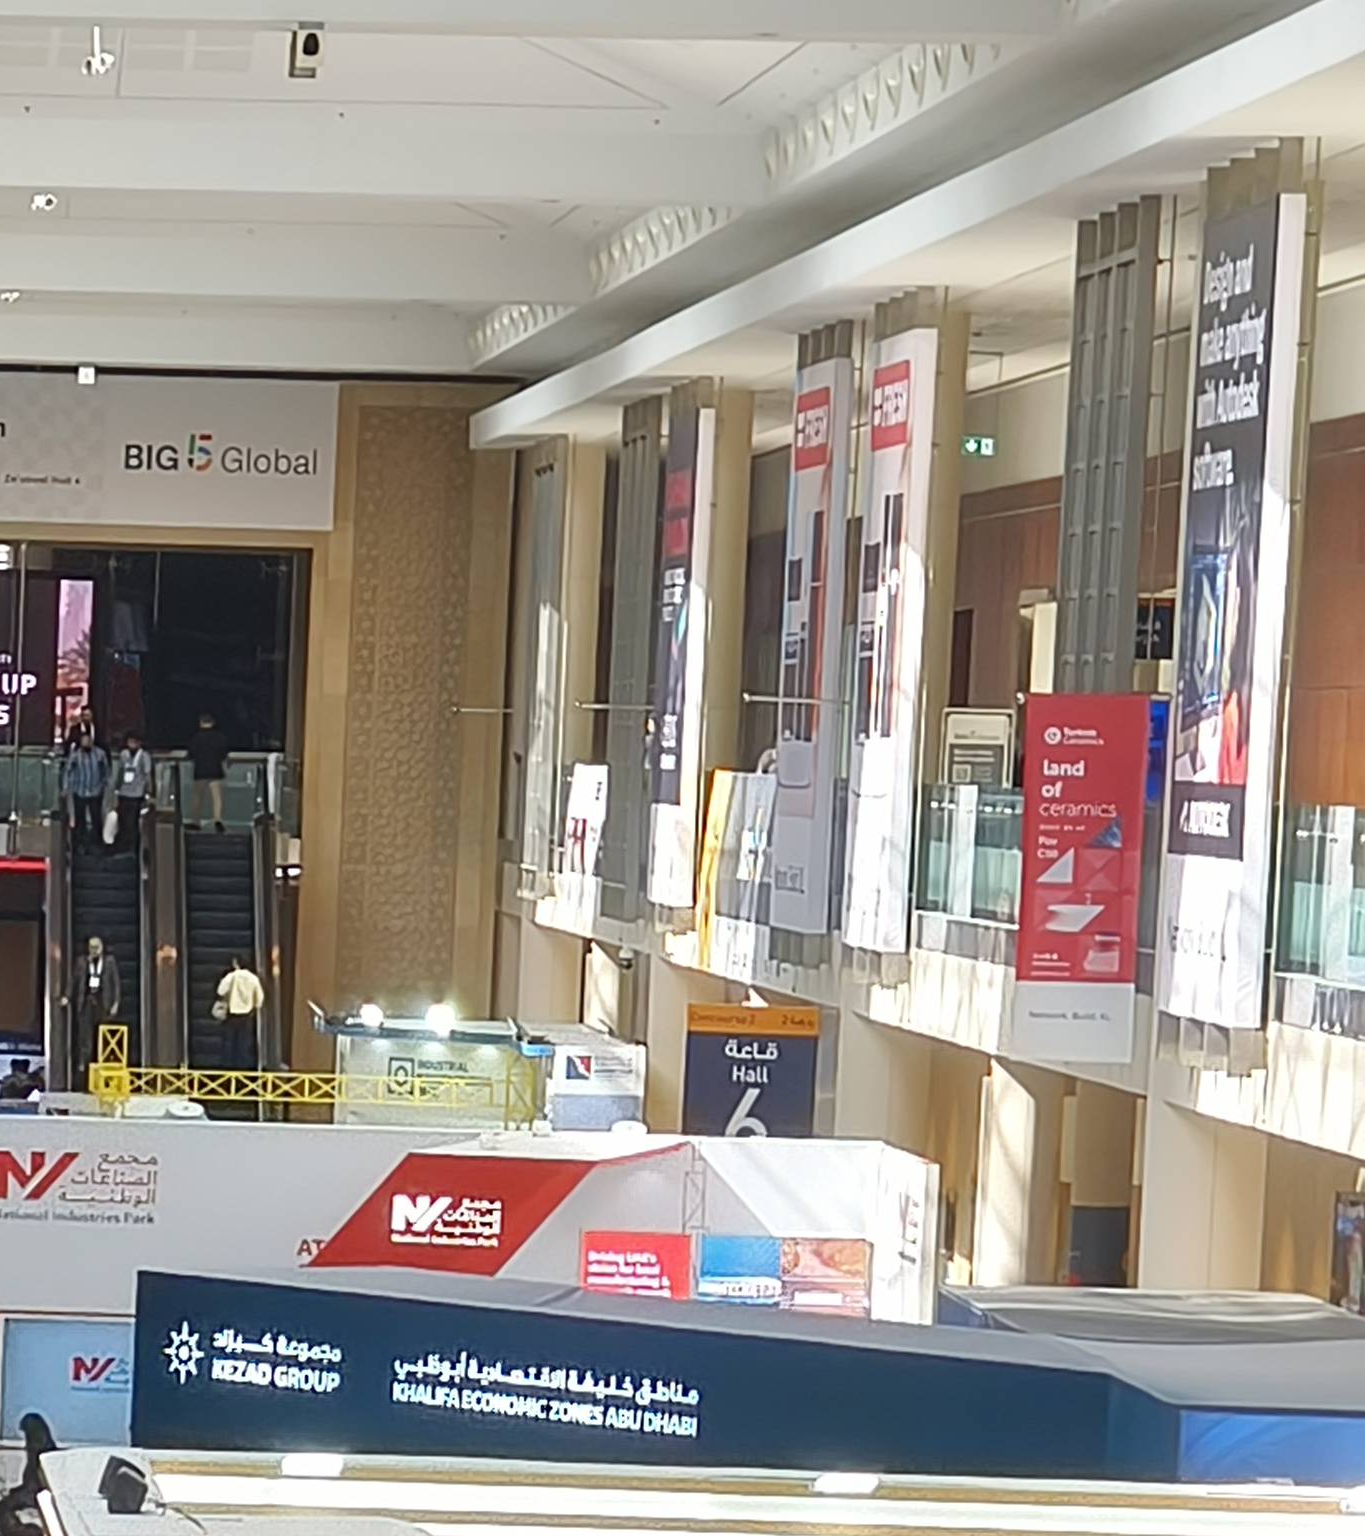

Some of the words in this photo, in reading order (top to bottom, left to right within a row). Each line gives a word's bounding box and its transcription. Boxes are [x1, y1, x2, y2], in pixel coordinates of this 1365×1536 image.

[124, 444, 178, 471] BIG
[188, 433, 213, 471] 5
[221, 446, 318, 475] Global
[2, 673, 37, 695] UP
[1041, 781, 1063, 798] of
[1039, 803, 1117, 818] ceramics
[725, 1038, 778, 1060] قاعة
[732, 1065, 768, 1083] Hall
[725, 1087, 767, 1137] 6
[124, 1212, 155, 1224] Park
[212, 1357, 272, 1386] KEZAD
[273, 1365, 341, 1392] GROUP
[392, 1381, 459, 1409] KHALIFA
[461, 1388, 547, 1419] ECONOMIC
[548, 1401, 604, 1427] ZONES
[605, 1407, 643, 1431] ABU
[643, 1411, 698, 1438] DHABI
